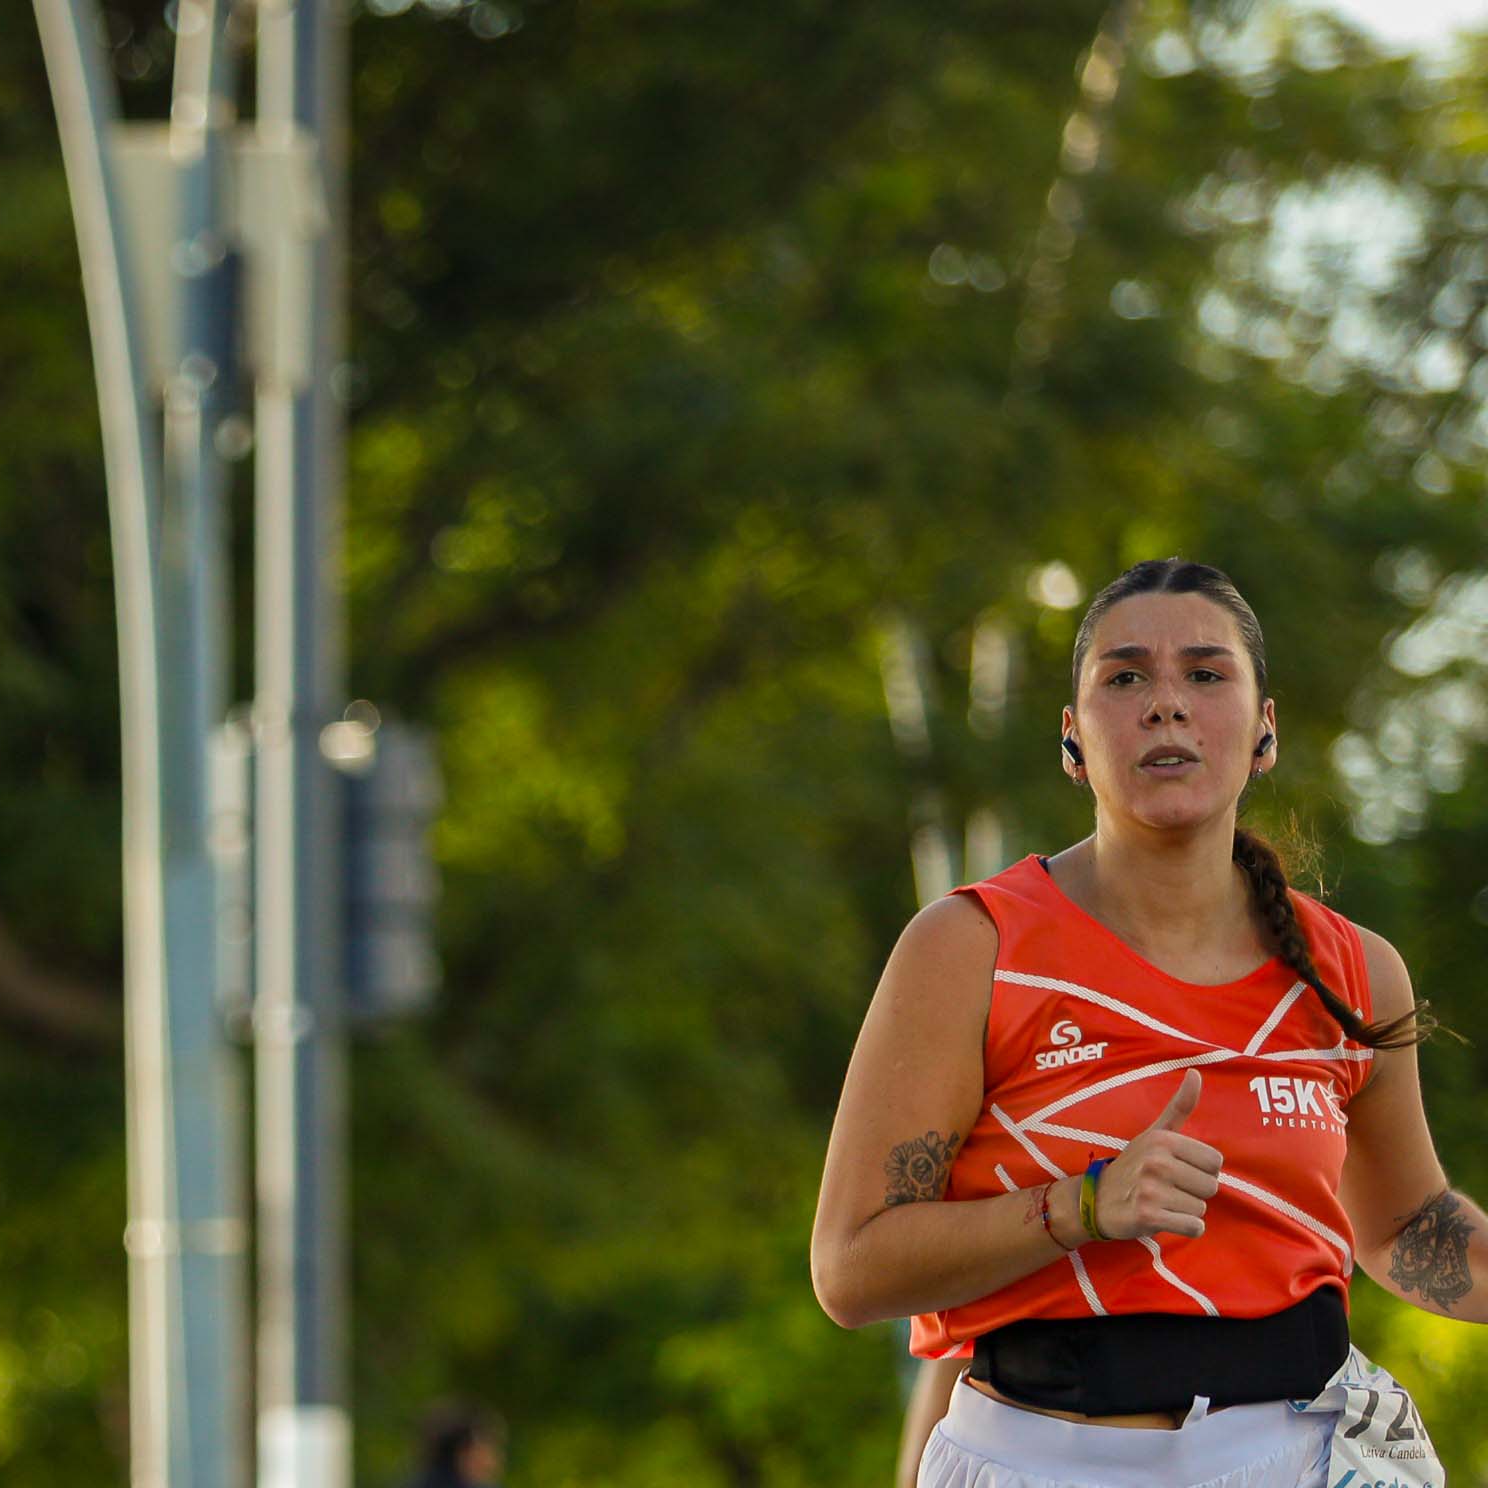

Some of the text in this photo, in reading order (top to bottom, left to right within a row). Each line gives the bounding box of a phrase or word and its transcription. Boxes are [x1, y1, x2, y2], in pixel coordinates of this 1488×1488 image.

[1249, 1076, 1324, 1117] 15K
[1262, 1116, 1326, 1131] PUERTO
[1359, 1444, 1386, 1459] Leiva
